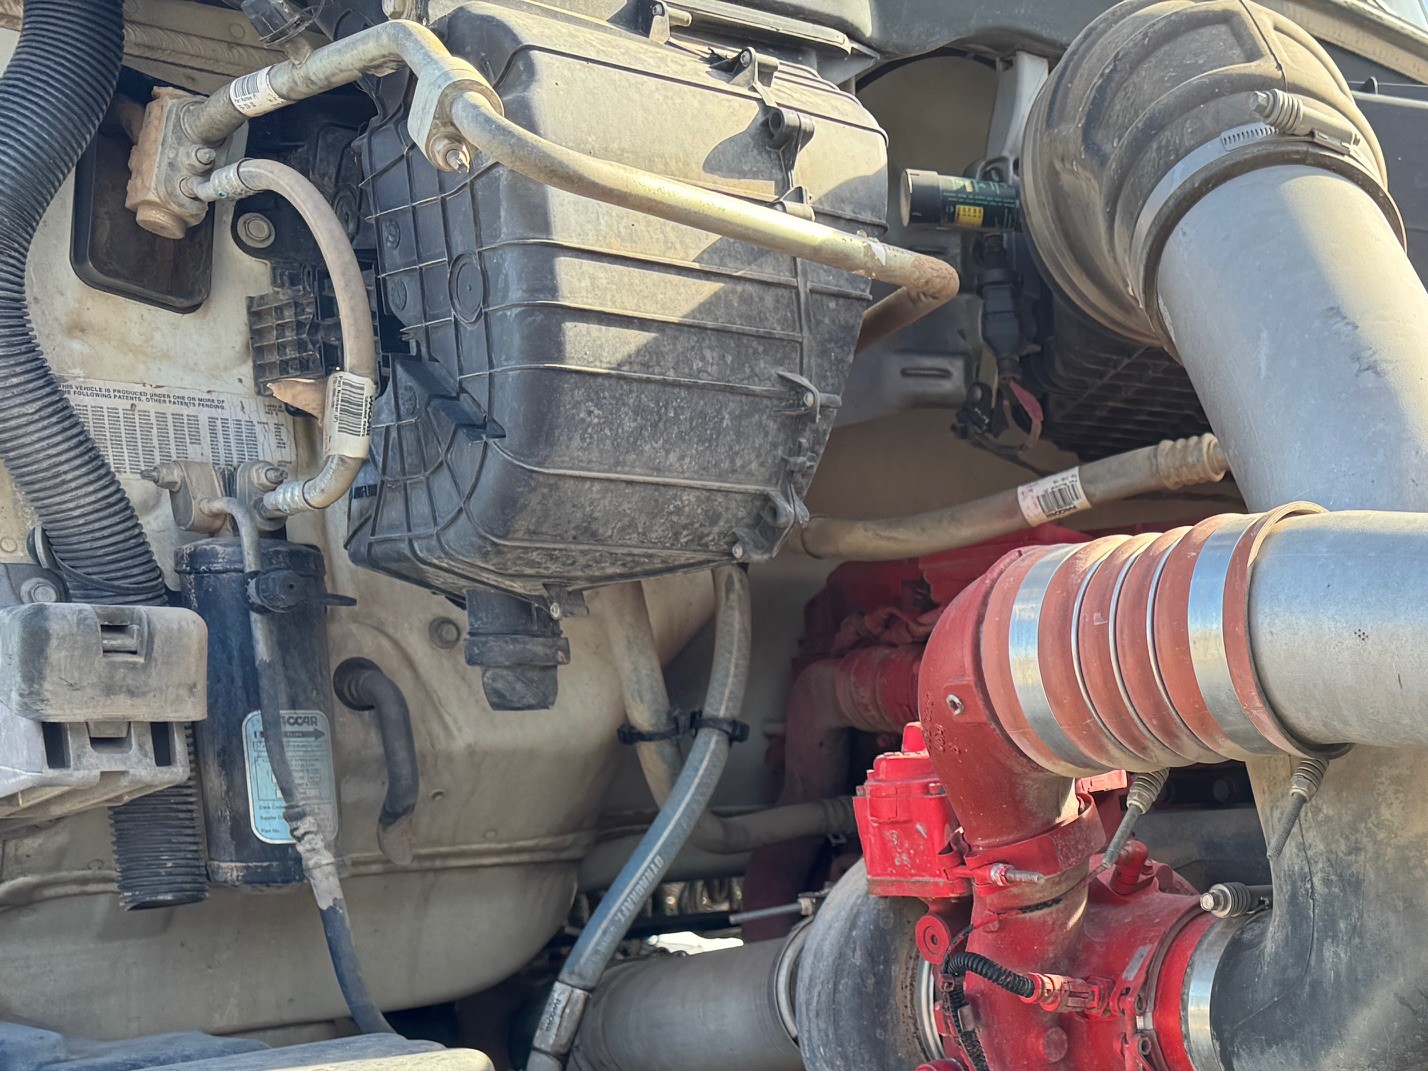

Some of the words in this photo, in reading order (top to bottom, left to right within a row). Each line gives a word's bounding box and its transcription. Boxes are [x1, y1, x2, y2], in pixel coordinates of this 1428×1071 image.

[73, 390, 112, 399] FOLLOWING
[168, 399, 197, 407] PATENTS
[75, 385, 103, 393] VEHICLE
[113, 389, 148, 397] PRODUCED
[149, 392, 171, 400] UNDER
